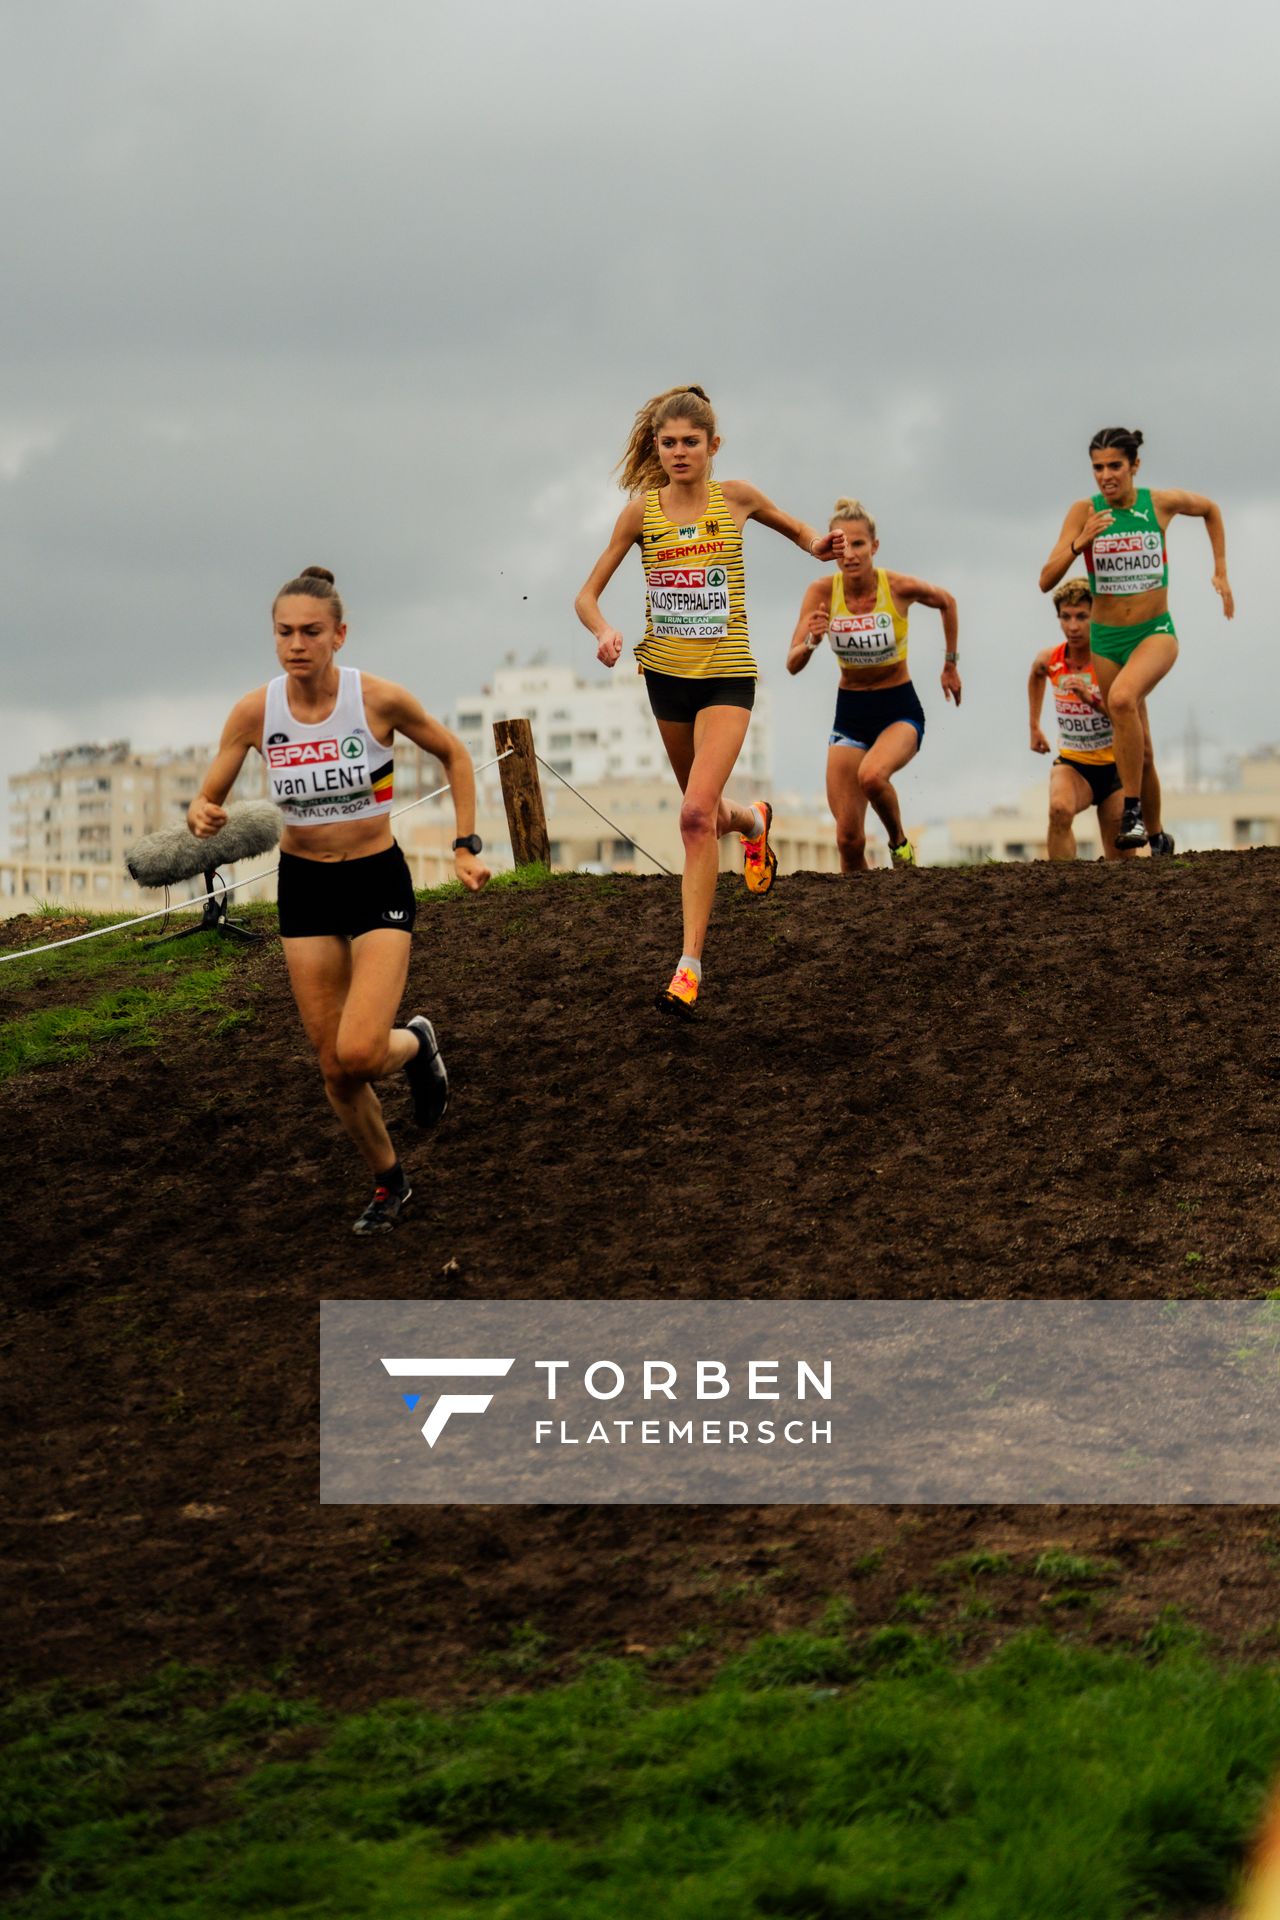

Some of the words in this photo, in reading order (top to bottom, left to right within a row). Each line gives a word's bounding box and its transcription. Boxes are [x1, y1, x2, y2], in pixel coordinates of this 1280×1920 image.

[656, 541, 725, 560] GERMANY
[1095, 538, 1142, 553] SPAR
[1096, 554, 1161, 571] MACHADO
[648, 571, 705, 587] SPAR
[1100, 583, 1138, 592] ANTALYA
[650, 591, 727, 611] KLOSTERHALFEN
[656, 626, 697, 636] ANTALYA
[699, 626, 723, 636] 2024
[831, 617, 875, 632] SPAR
[835, 633, 889, 648] LAHTI
[1058, 716, 1111, 732] ROBLES
[270, 742, 338, 767] SPAR
[274, 778, 307, 796] van
[312, 765, 365, 792] LENT
[341, 798, 371, 815] 2024
